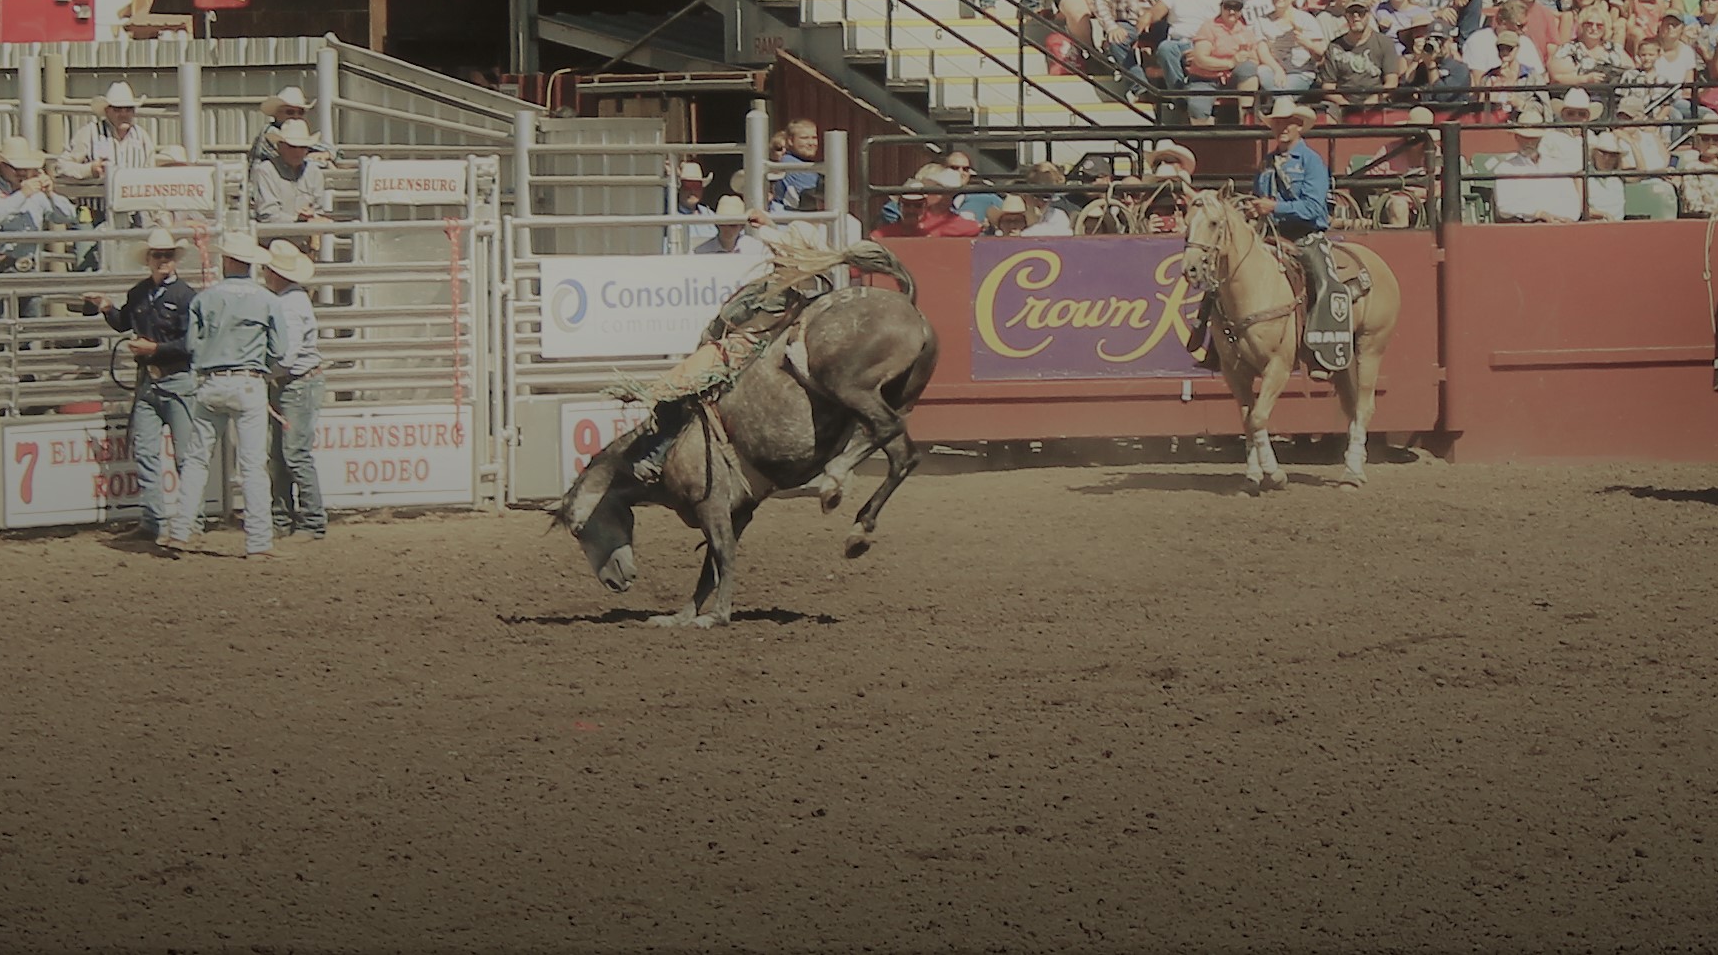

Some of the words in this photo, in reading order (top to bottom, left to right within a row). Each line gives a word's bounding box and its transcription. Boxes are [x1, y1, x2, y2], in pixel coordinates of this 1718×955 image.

[121, 182, 205, 198] ELLENSBURG
[373, 178, 457, 192] ELLENSBURG
[601, 276, 742, 309] Consolida
[975, 249, 1152, 359] Crown
[601, 314, 711, 334] communi
[573, 419, 601, 474] 9
[15, 442, 39, 504] 7
[92, 470, 177, 498] RODO
[346, 458, 430, 484] RODEO
